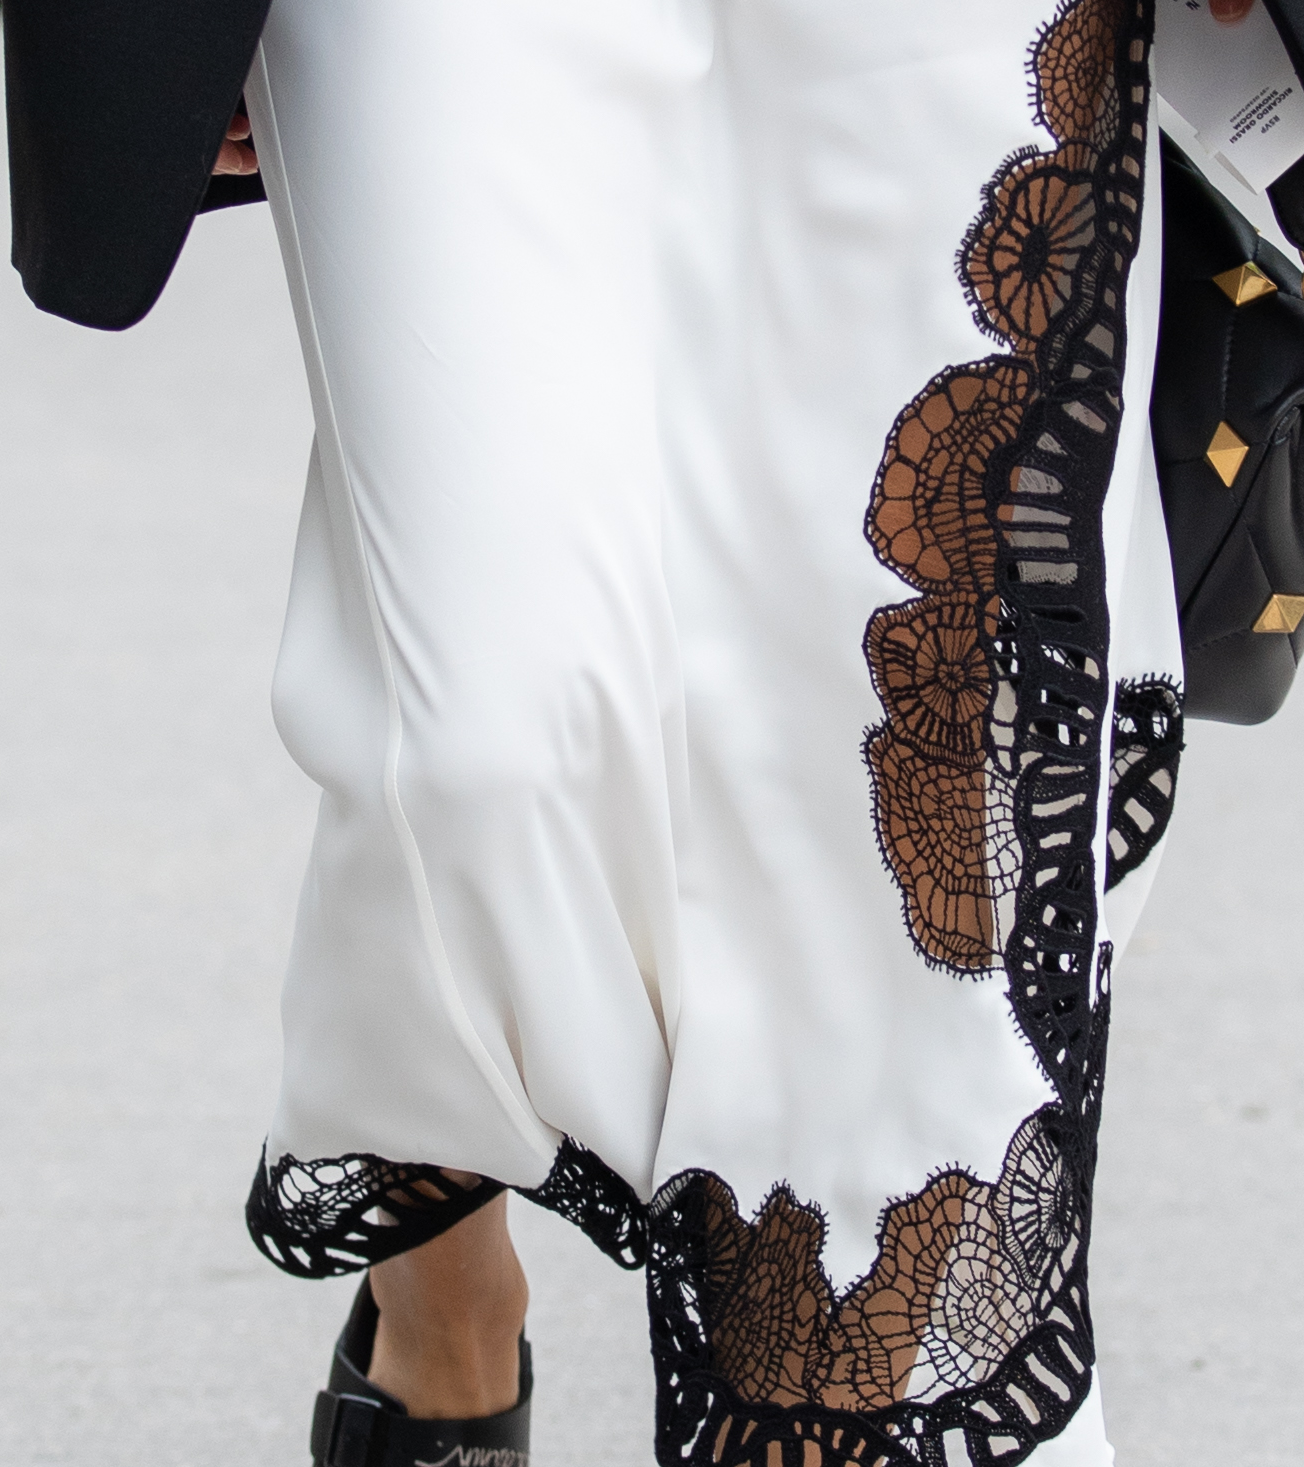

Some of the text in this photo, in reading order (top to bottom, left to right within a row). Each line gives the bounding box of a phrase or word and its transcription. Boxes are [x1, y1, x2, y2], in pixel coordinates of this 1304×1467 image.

[1229, 87, 1293, 144] RICCARDO GRASSI
[1233, 89, 1279, 130] SHOWROOM
[1261, 114, 1281, 134] RSVP
